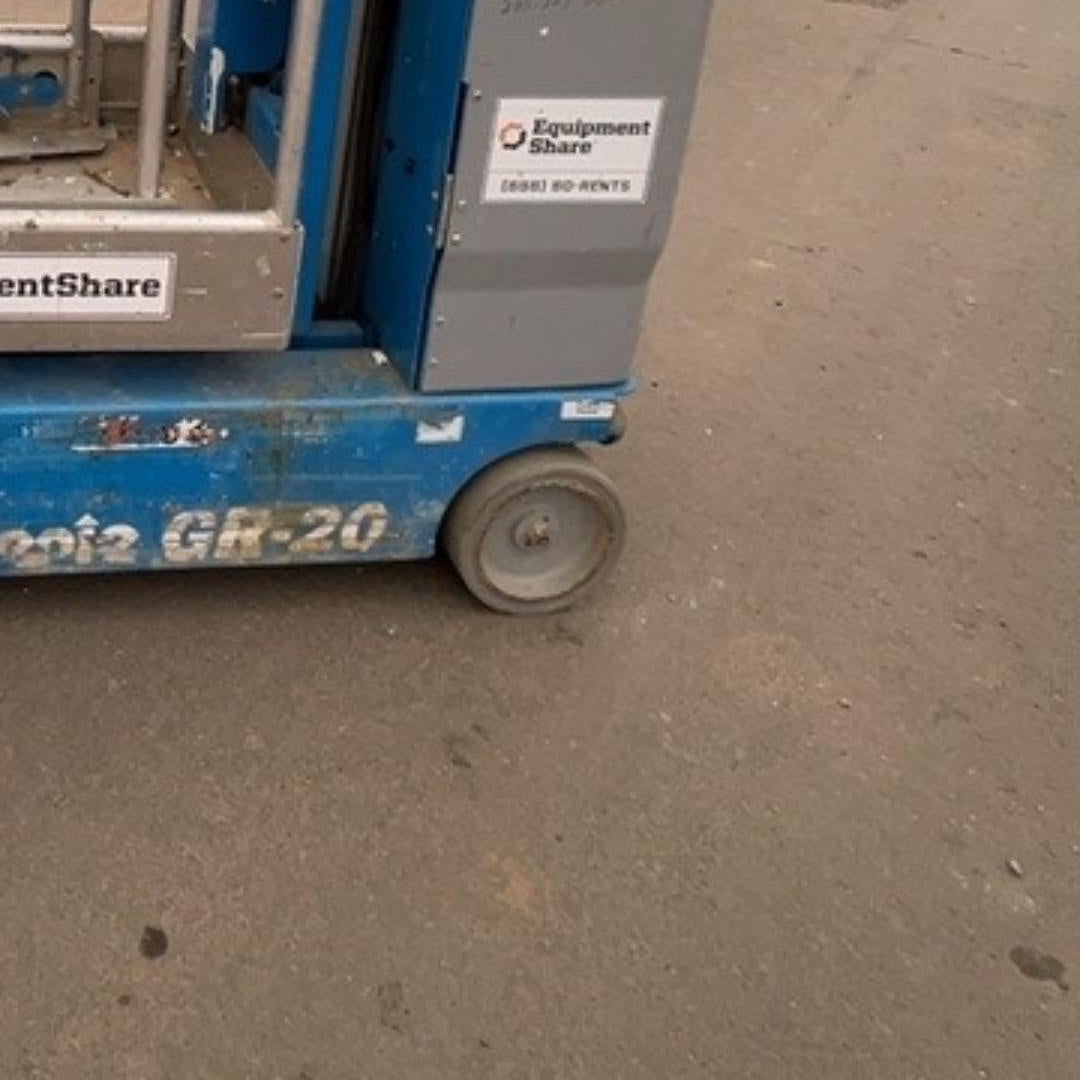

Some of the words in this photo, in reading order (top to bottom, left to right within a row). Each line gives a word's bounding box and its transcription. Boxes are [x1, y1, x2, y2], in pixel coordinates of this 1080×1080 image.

[532, 119, 652, 139] Equipment
[528, 137, 593, 155] Share
[161, 502, 389, 563] GR-20
